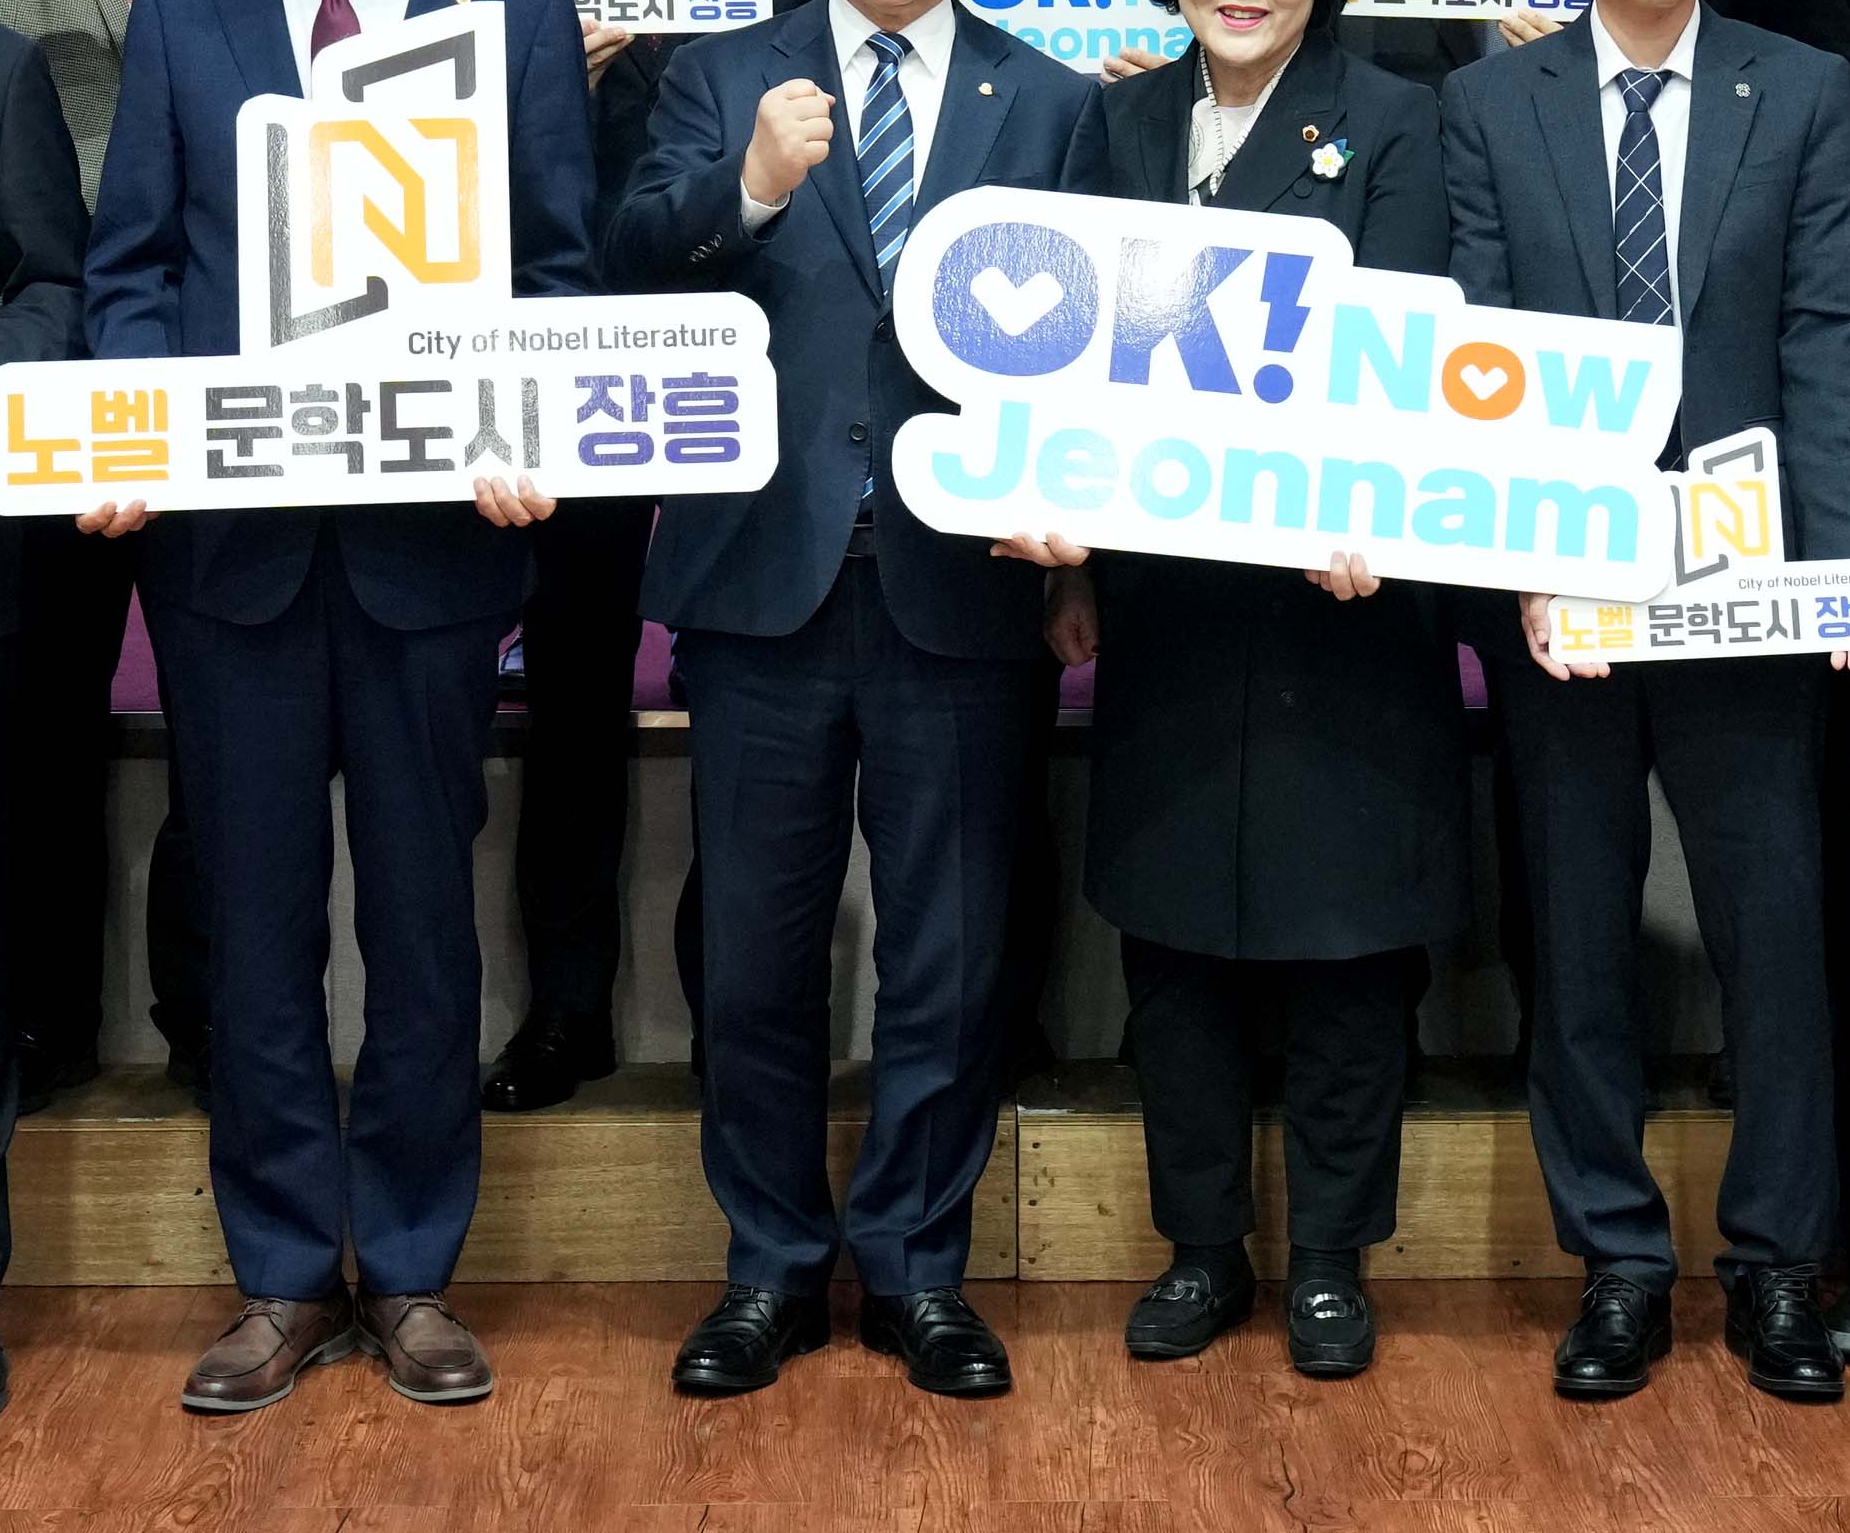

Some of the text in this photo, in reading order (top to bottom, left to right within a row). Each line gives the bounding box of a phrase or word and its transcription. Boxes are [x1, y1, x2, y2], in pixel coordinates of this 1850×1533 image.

[409, 324, 737, 360] City of Nobel Literature
[932, 220, 1651, 433] OK! Now
[7, 372, 741, 486] 노벨 문학도시 장흥
[930, 403, 1643, 564] Jeonnam
[1739, 579, 1762, 591] City
[1767, 576, 1779, 588] of
[1784, 575, 1820, 587] Nobel
[1560, 608, 1634, 650] 노벨
[1648, 599, 1801, 647] 문학도시
